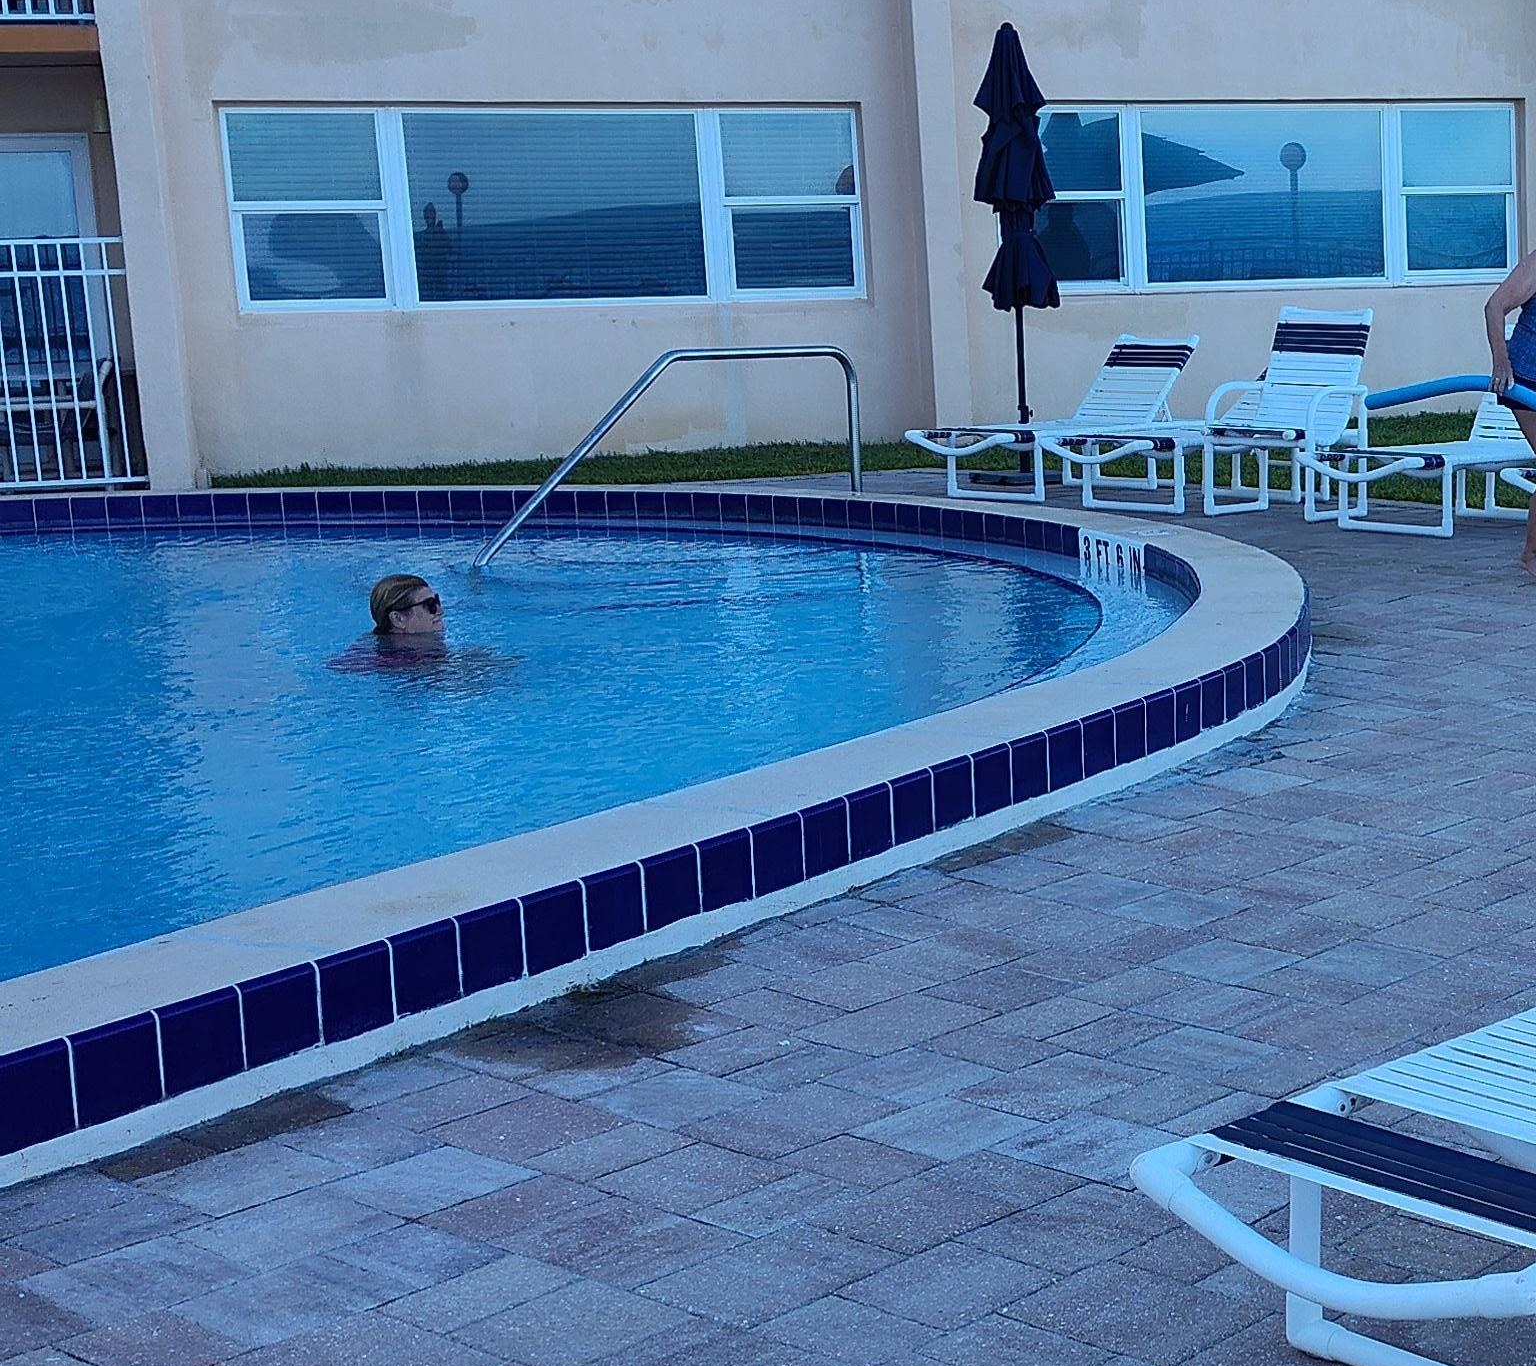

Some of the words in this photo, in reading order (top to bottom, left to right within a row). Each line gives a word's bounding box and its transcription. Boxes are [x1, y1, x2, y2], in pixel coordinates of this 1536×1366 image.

[1083, 535, 1091, 560] 3
[1095, 538, 1110, 565] FT
[1116, 543, 1124, 568] 6
[1128, 546, 1140, 573] IN
